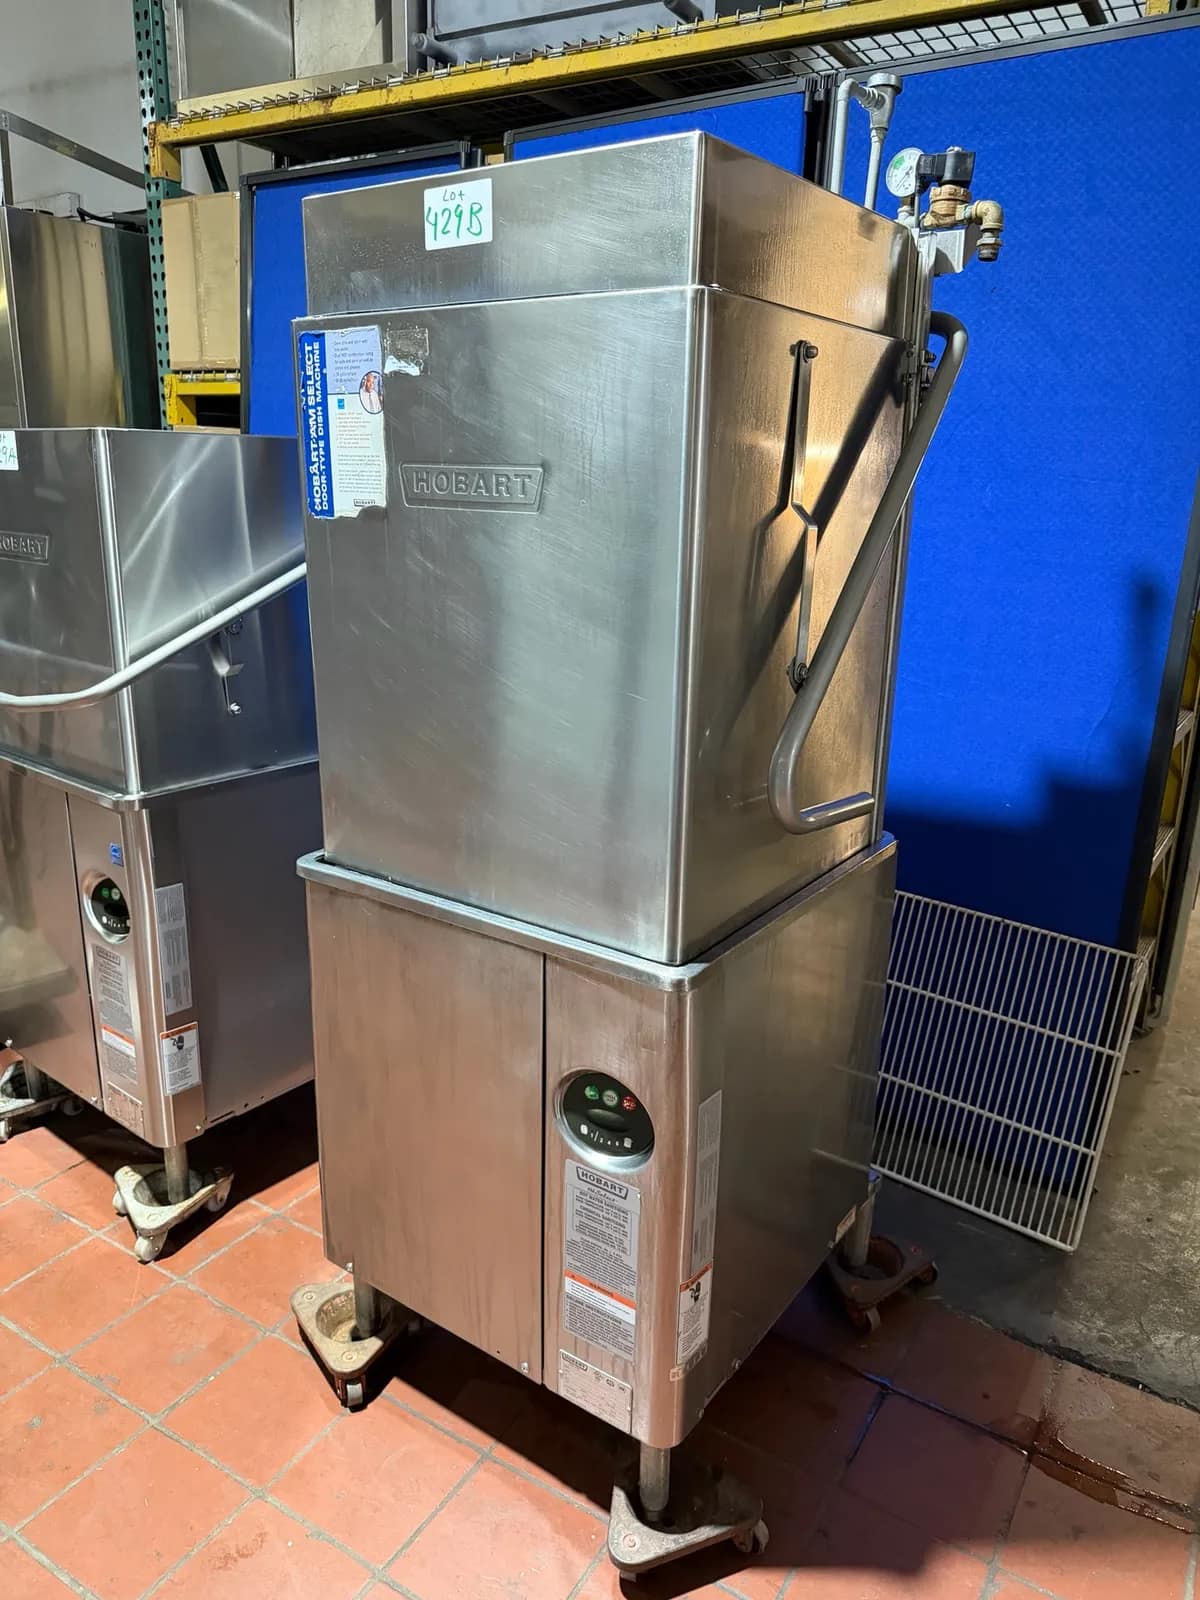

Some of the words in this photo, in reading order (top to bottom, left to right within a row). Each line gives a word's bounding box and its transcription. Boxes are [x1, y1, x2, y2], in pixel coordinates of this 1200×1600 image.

[443, 189, 465, 201] Lot
[425, 202, 482, 241] 429B
[305, 342, 315, 406] SELECT
[313, 342, 323, 403] MACHINE
[316, 406, 325, 436] DISH
[319, 440, 329, 511] DOOR-TYPE
[413, 471, 532, 498] HOBART
[581, 1171, 624, 1195] HOBART
